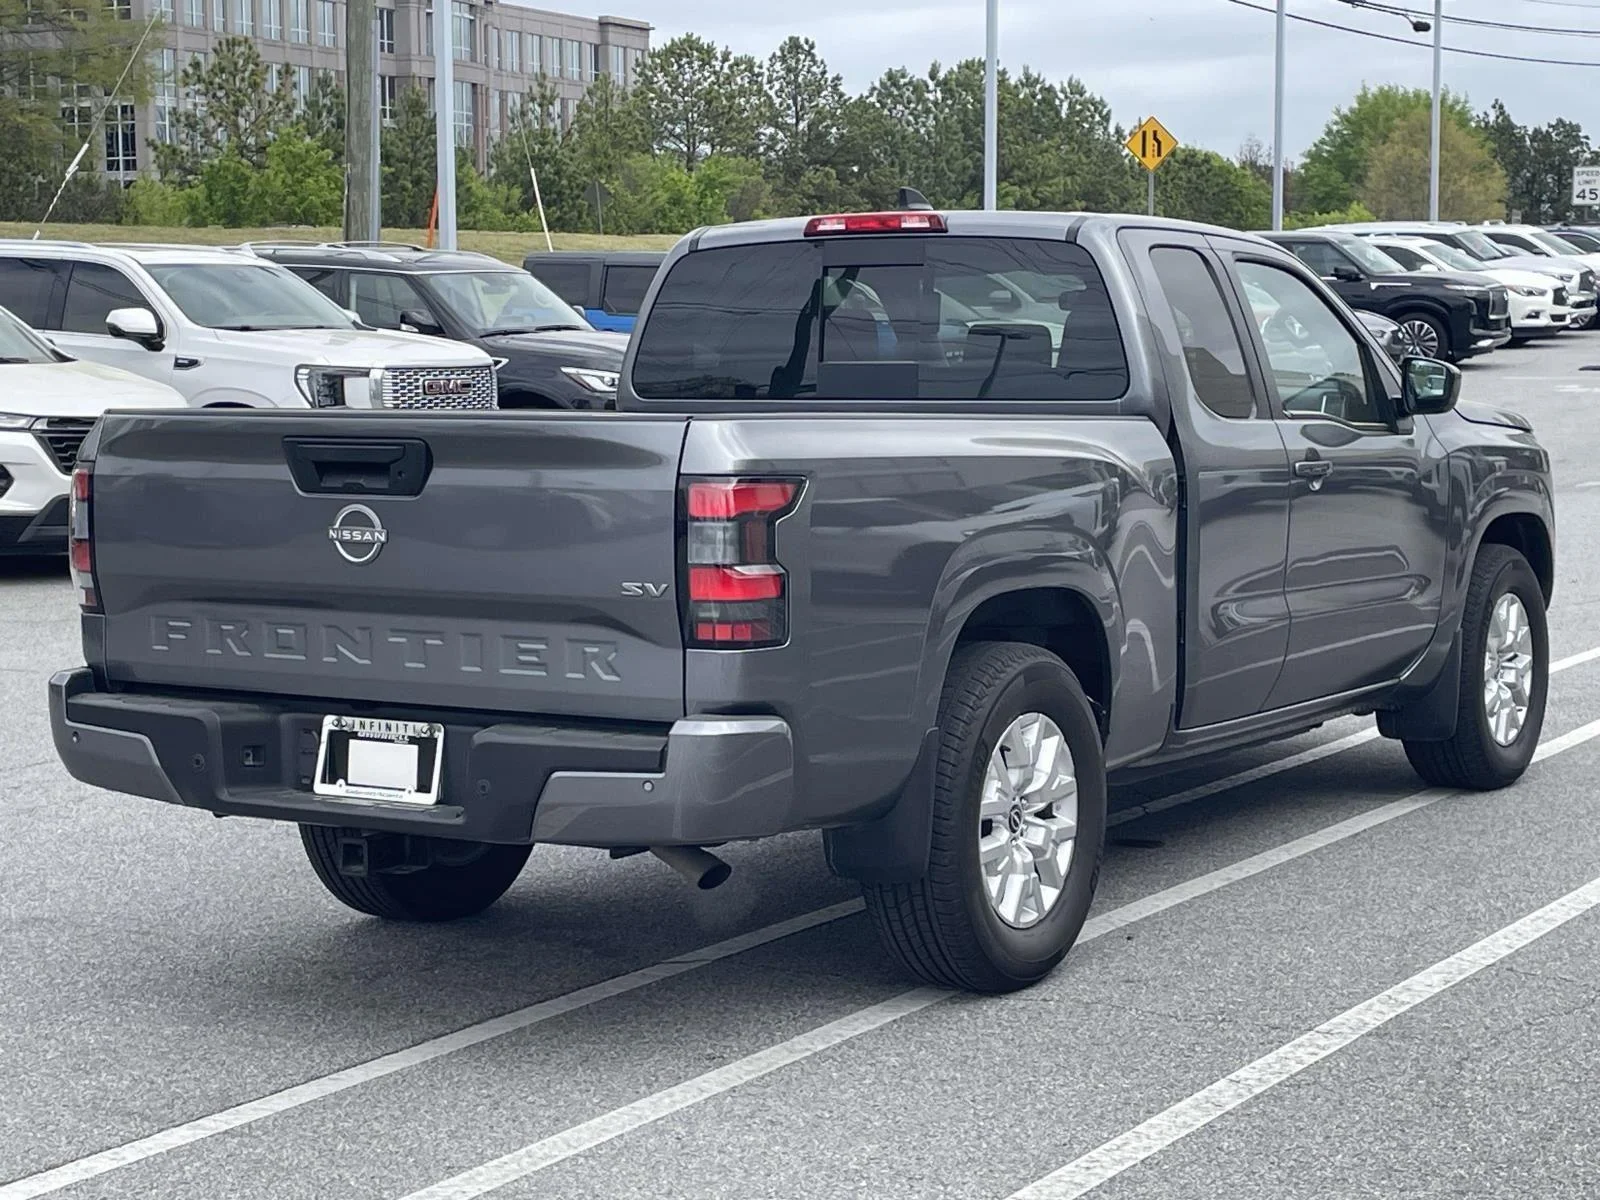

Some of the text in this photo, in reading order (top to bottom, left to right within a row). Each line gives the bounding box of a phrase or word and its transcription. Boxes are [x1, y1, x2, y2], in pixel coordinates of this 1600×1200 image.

[1575, 188, 1599, 201] 45
[424, 379, 473, 395] GMC
[328, 529, 386, 542] NISSAN
[621, 581, 669, 598] SV
[150, 614, 623, 683] FRONTIER
[351, 719, 417, 735] INFINITI
